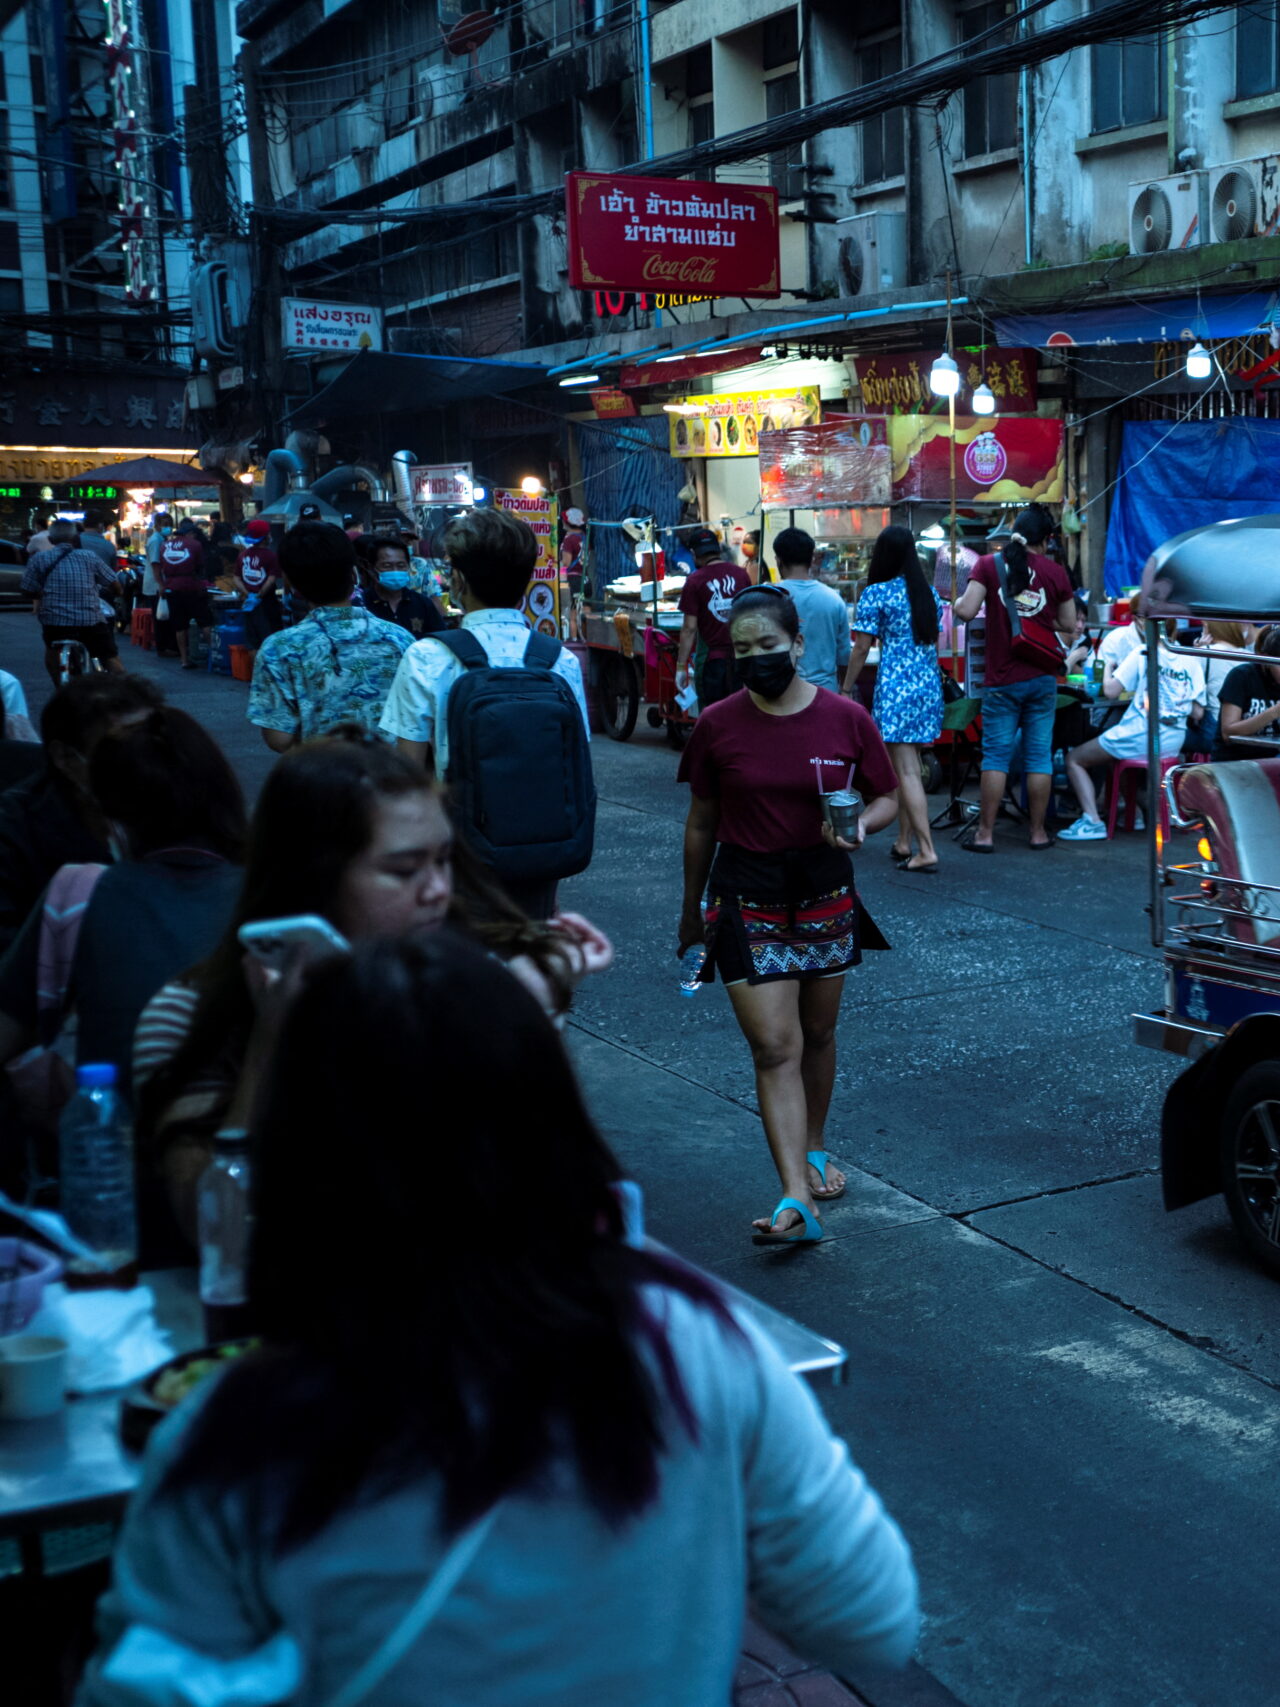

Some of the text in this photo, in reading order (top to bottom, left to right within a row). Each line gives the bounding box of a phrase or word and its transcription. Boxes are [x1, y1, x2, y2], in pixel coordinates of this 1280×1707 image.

[645, 191, 757, 222] ข้าวต้มปลา
[624, 214, 737, 247] ยำสามแซ่บ
[641, 253, 719, 283] Coca-Cola
[293, 305, 372, 328] แสงอรุณ
